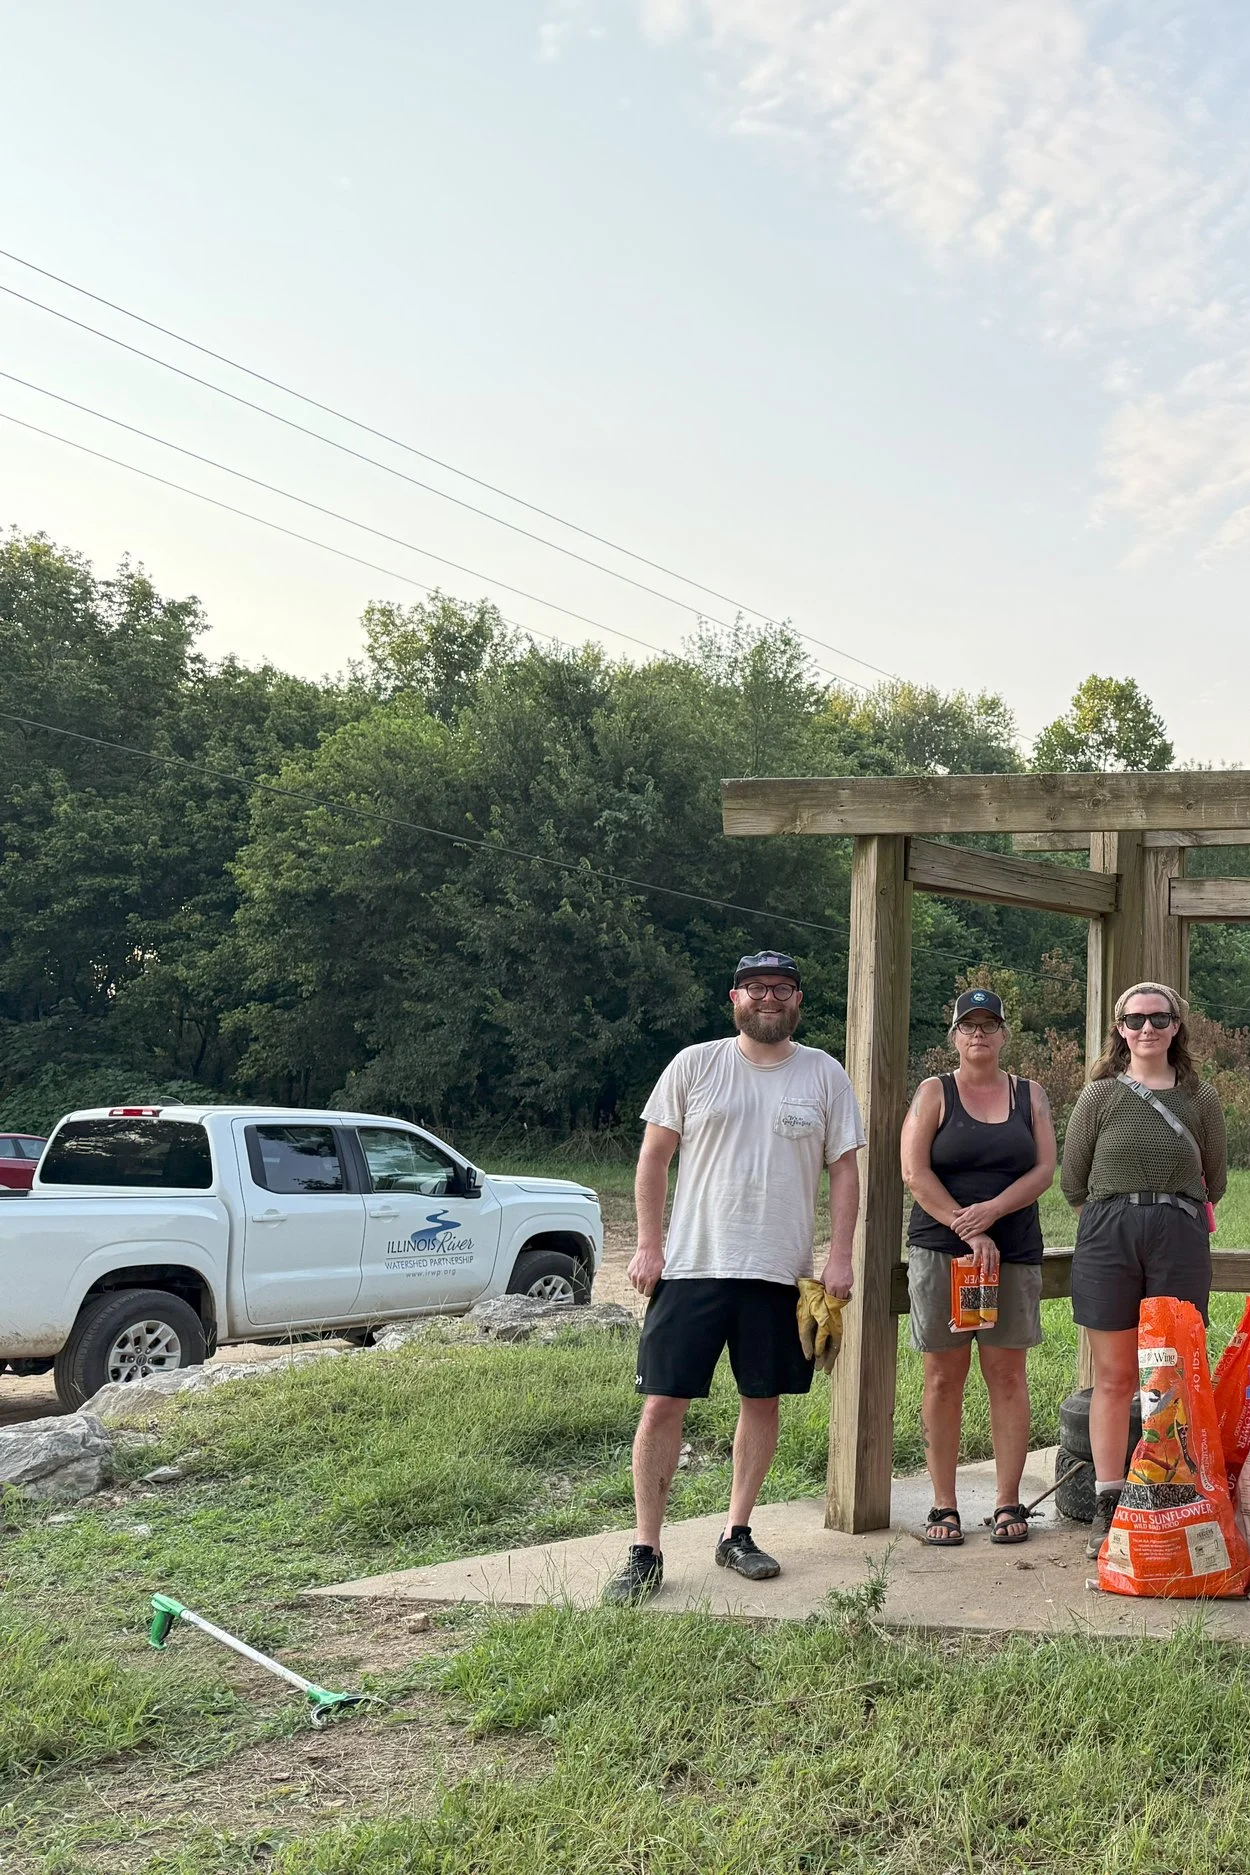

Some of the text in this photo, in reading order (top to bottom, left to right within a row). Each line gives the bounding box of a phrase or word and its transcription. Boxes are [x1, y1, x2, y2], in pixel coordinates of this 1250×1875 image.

[387, 1231, 475, 1254] ILLINOIS River
[385, 1255, 474, 1270] WATERSHED PARTNERSHIP
[405, 1268, 457, 1278] www.irwp.org
[1154, 1351, 1176, 1365] Wing
[1193, 1373, 1200, 1393] 40
[1115, 1503, 1213, 1525] LACK OIL SUNFLOWER
